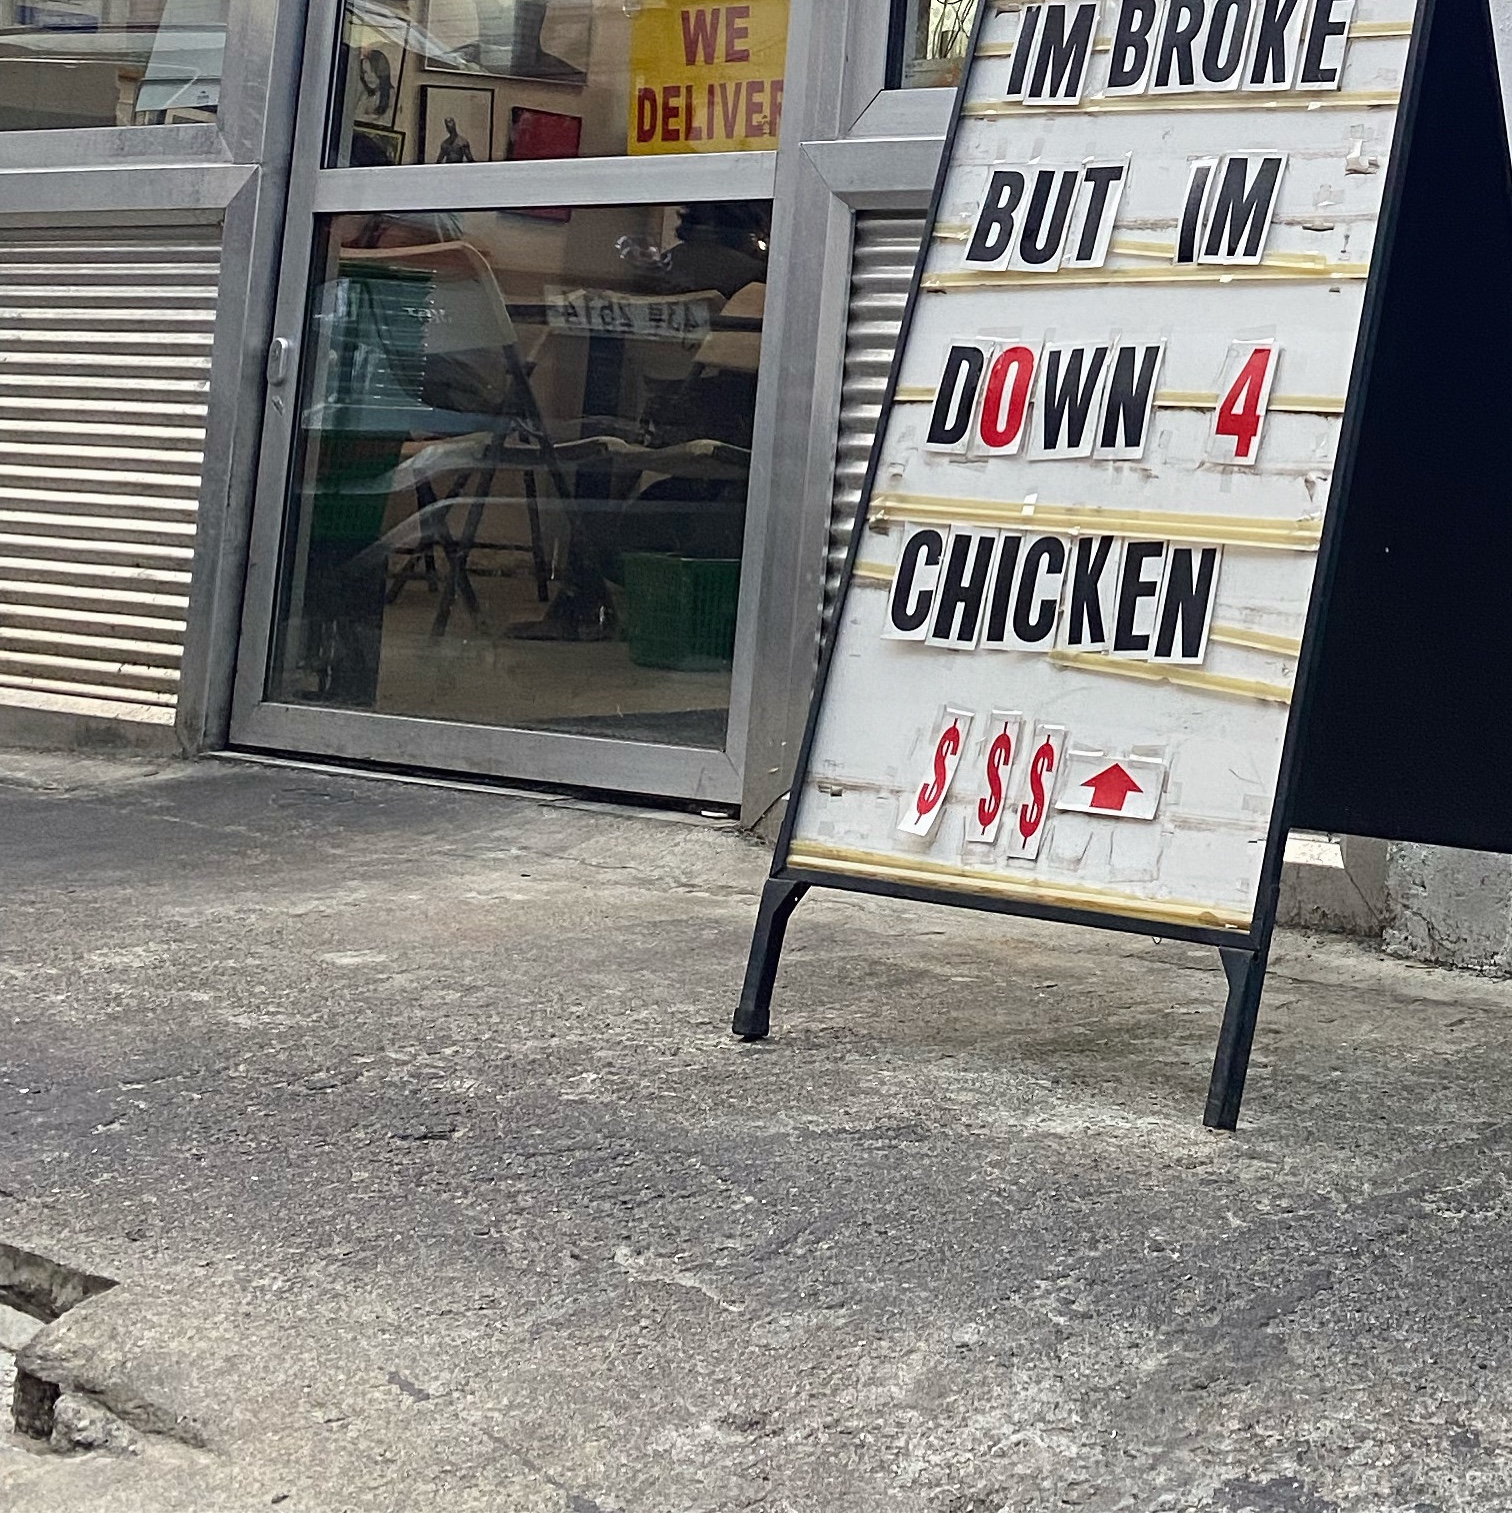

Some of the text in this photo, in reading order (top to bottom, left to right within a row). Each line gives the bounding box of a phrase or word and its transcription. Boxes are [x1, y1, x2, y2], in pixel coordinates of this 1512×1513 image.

[680, 5, 750, 67] WE
[636, 78, 784, 144] DELIVER
[965, 157, 1283, 264] BUT IM
[925, 345, 1271, 458] DOWN 4
[890, 528, 1217, 659] CHICKEN
